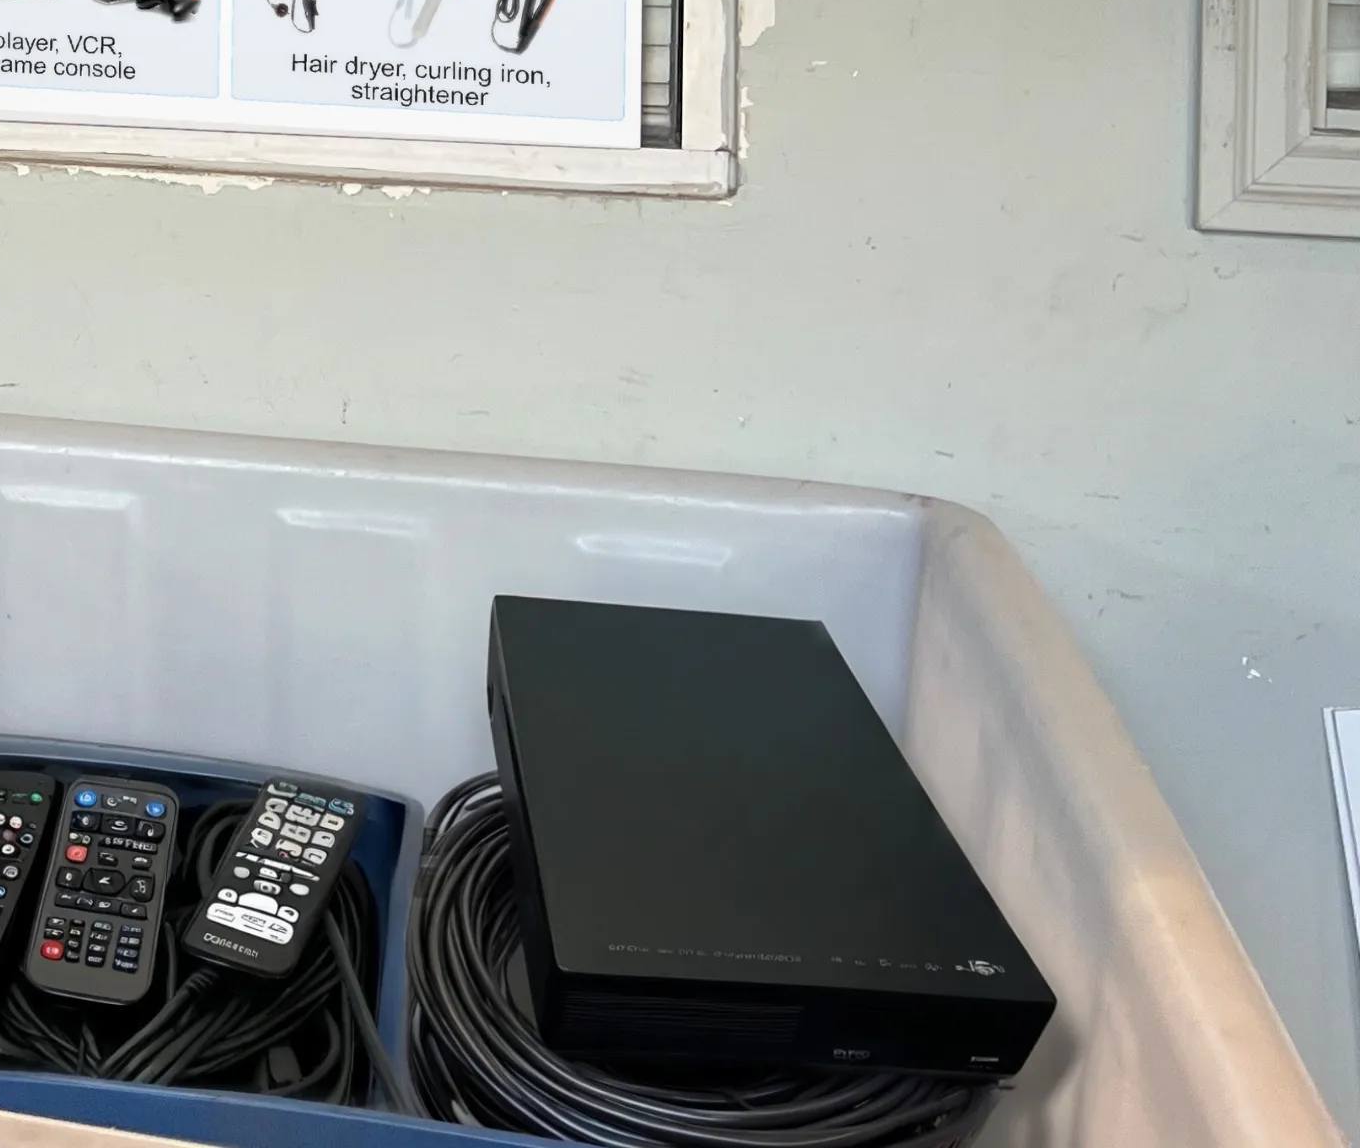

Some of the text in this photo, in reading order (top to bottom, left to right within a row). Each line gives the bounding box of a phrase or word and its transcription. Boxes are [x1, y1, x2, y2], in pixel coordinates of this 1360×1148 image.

[67, 34, 122, 58] VCR,
[53, 60, 136, 79] console
[292, 53, 550, 87] Hair dryer, curling iron,
[351, 82, 489, 107] straightener
